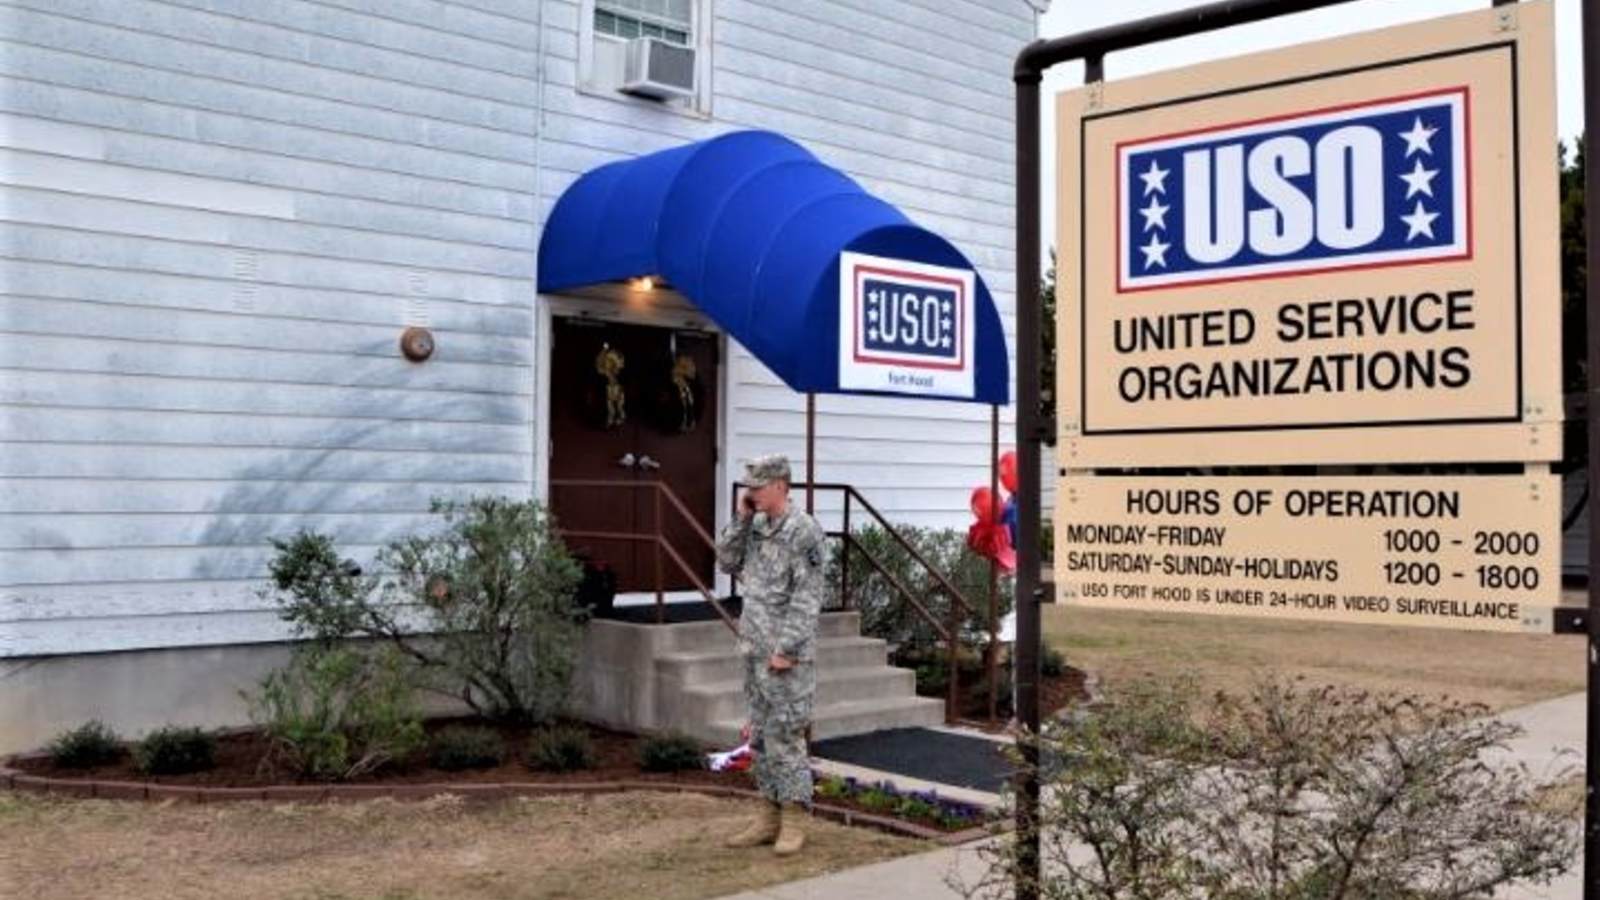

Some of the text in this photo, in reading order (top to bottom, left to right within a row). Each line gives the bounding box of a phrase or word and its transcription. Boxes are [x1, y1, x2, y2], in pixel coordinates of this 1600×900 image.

[1182, 125, 1385, 263] USO
[879, 290, 940, 347] USO
[1114, 290, 1475, 353] UNITED SERVICE
[1118, 346, 1471, 402] ORGANIZATIONS
[1126, 488, 1460, 518] HOURS OF OPERATION
[1067, 524, 1226, 547] MONDAY-FRIDAY
[1383, 529, 1440, 553] 1000
[1474, 531, 1540, 556] 2000
[1067, 552, 1339, 582] SATURDAY-SUNDAY-HOLIDAYS
[1383, 562, 1440, 586] 1200
[1477, 566, 1540, 590] 1800
[1081, 583, 1520, 620] USO FORT HOOD IS UNDER 24-HOUR VIDEO SURVEILLANCE
